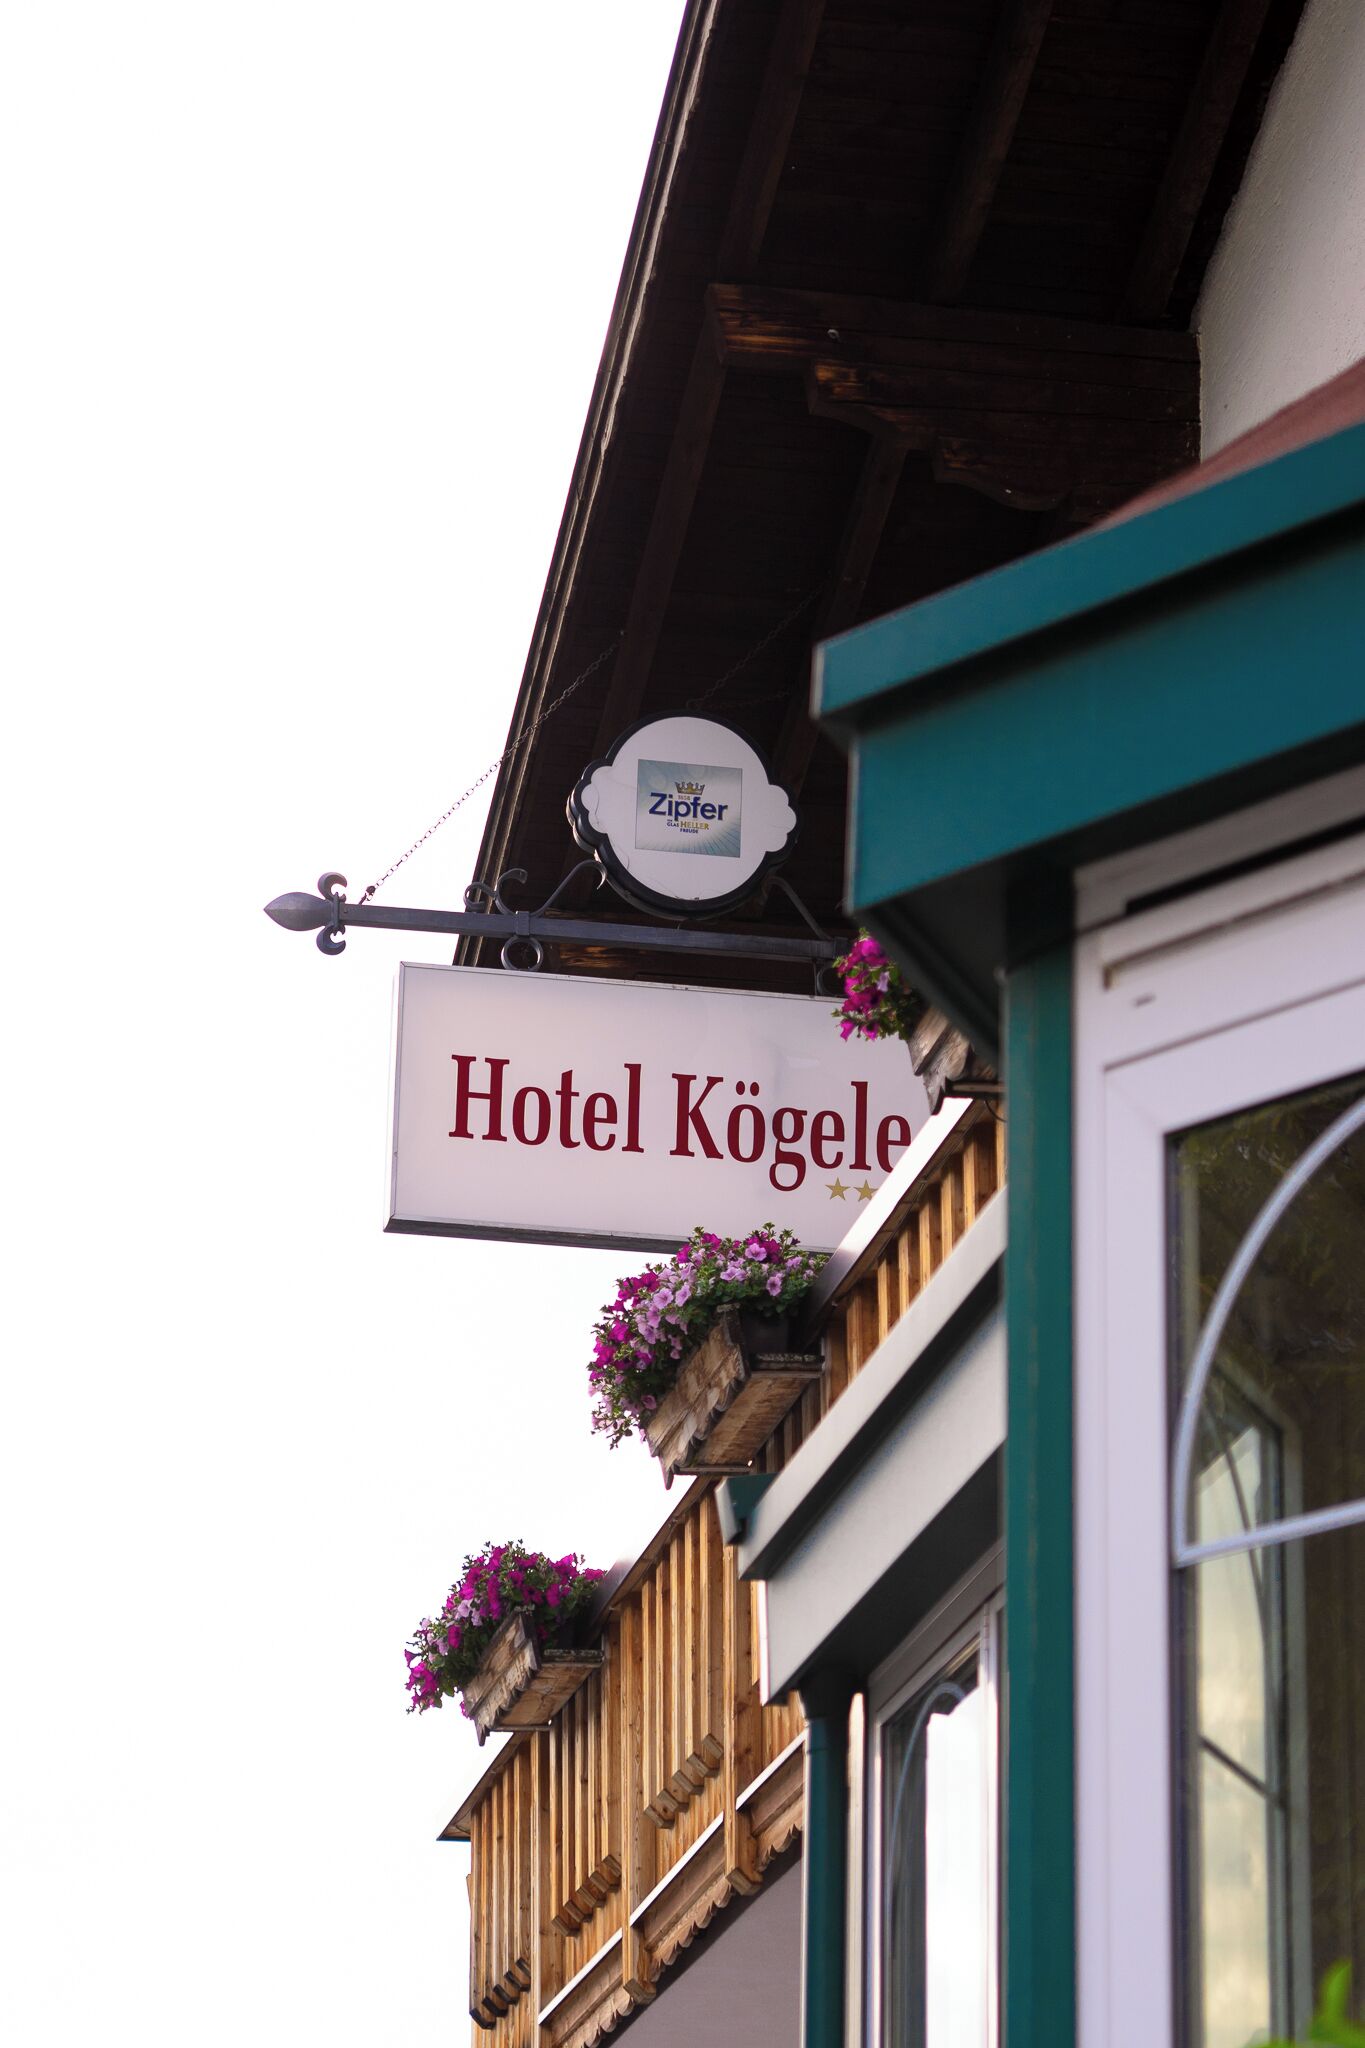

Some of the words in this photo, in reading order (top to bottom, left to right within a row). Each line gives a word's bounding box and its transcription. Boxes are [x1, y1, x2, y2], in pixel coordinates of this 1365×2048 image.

[649, 792, 728, 821] Zipfer
[680, 821, 709, 830] HELLER
[448, 1054, 645, 1153] Hotel
[669, 1072, 912, 1192] Kögele
